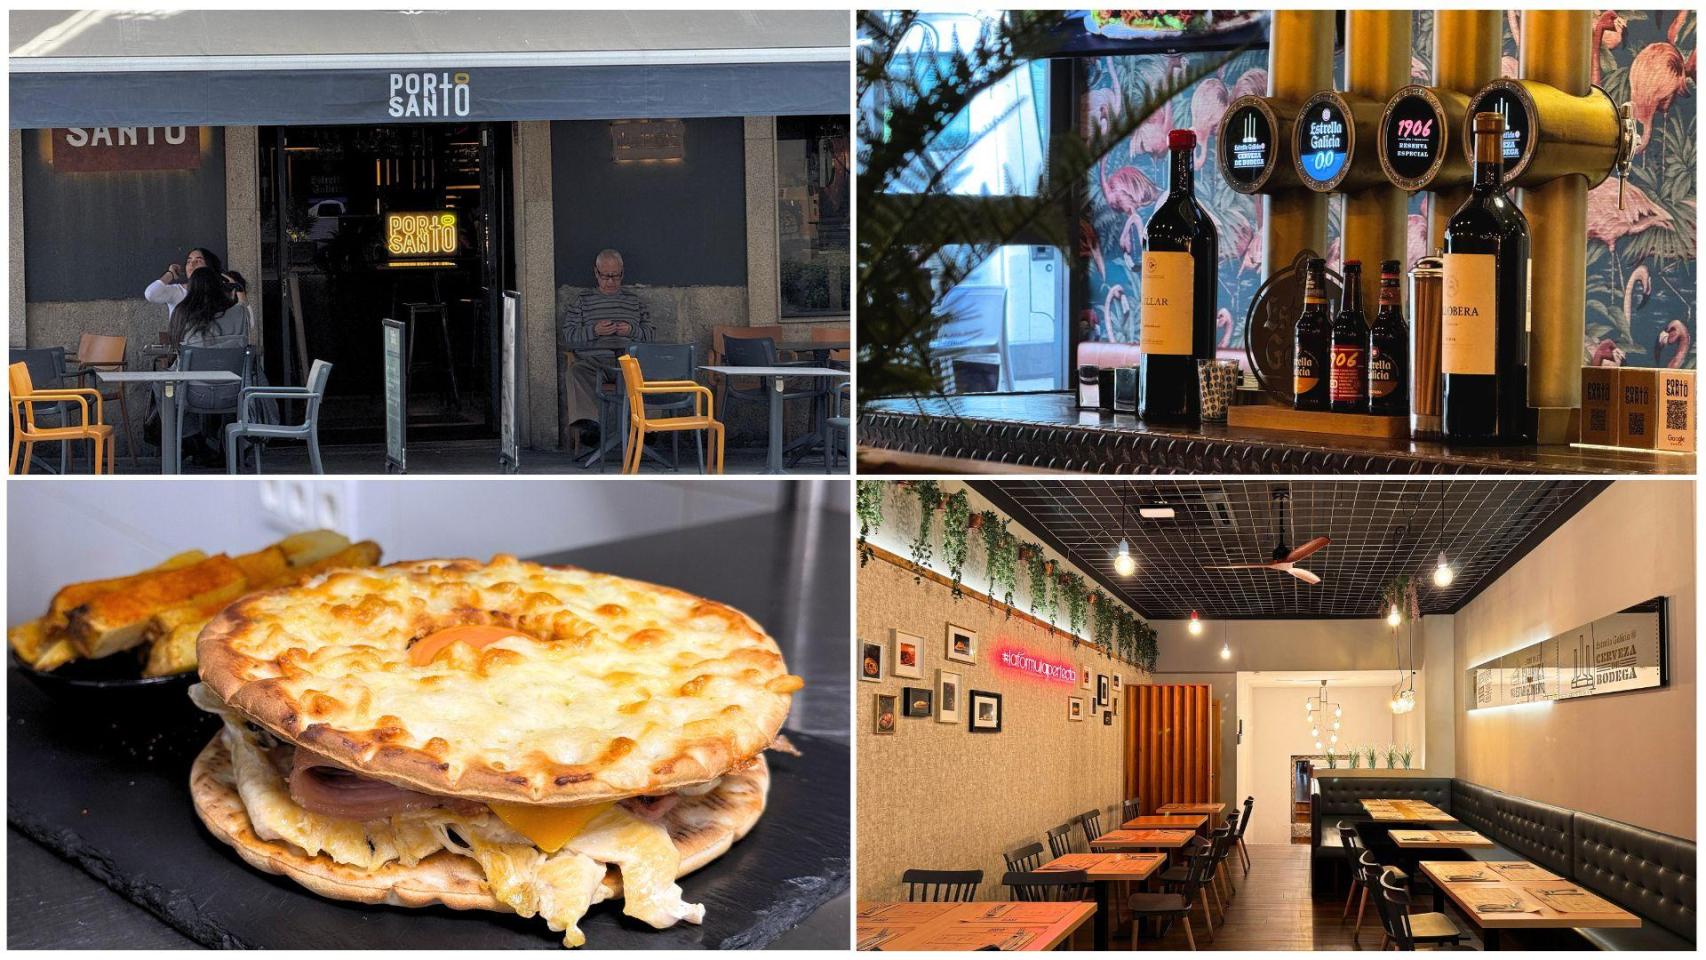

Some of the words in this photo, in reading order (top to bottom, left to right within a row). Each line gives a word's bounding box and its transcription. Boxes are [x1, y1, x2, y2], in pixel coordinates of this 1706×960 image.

[388, 91, 470, 117] SANTO
[1310, 121, 1342, 135] Estrella
[1398, 119, 1433, 138] 1906
[1311, 135, 1340, 149] Galicia
[1397, 150, 1428, 158] ESPECIAL
[389, 230, 456, 253] SANTO
[1596, 644, 1637, 664] CERVEZA
[1596, 665, 1638, 685] BODEGA
